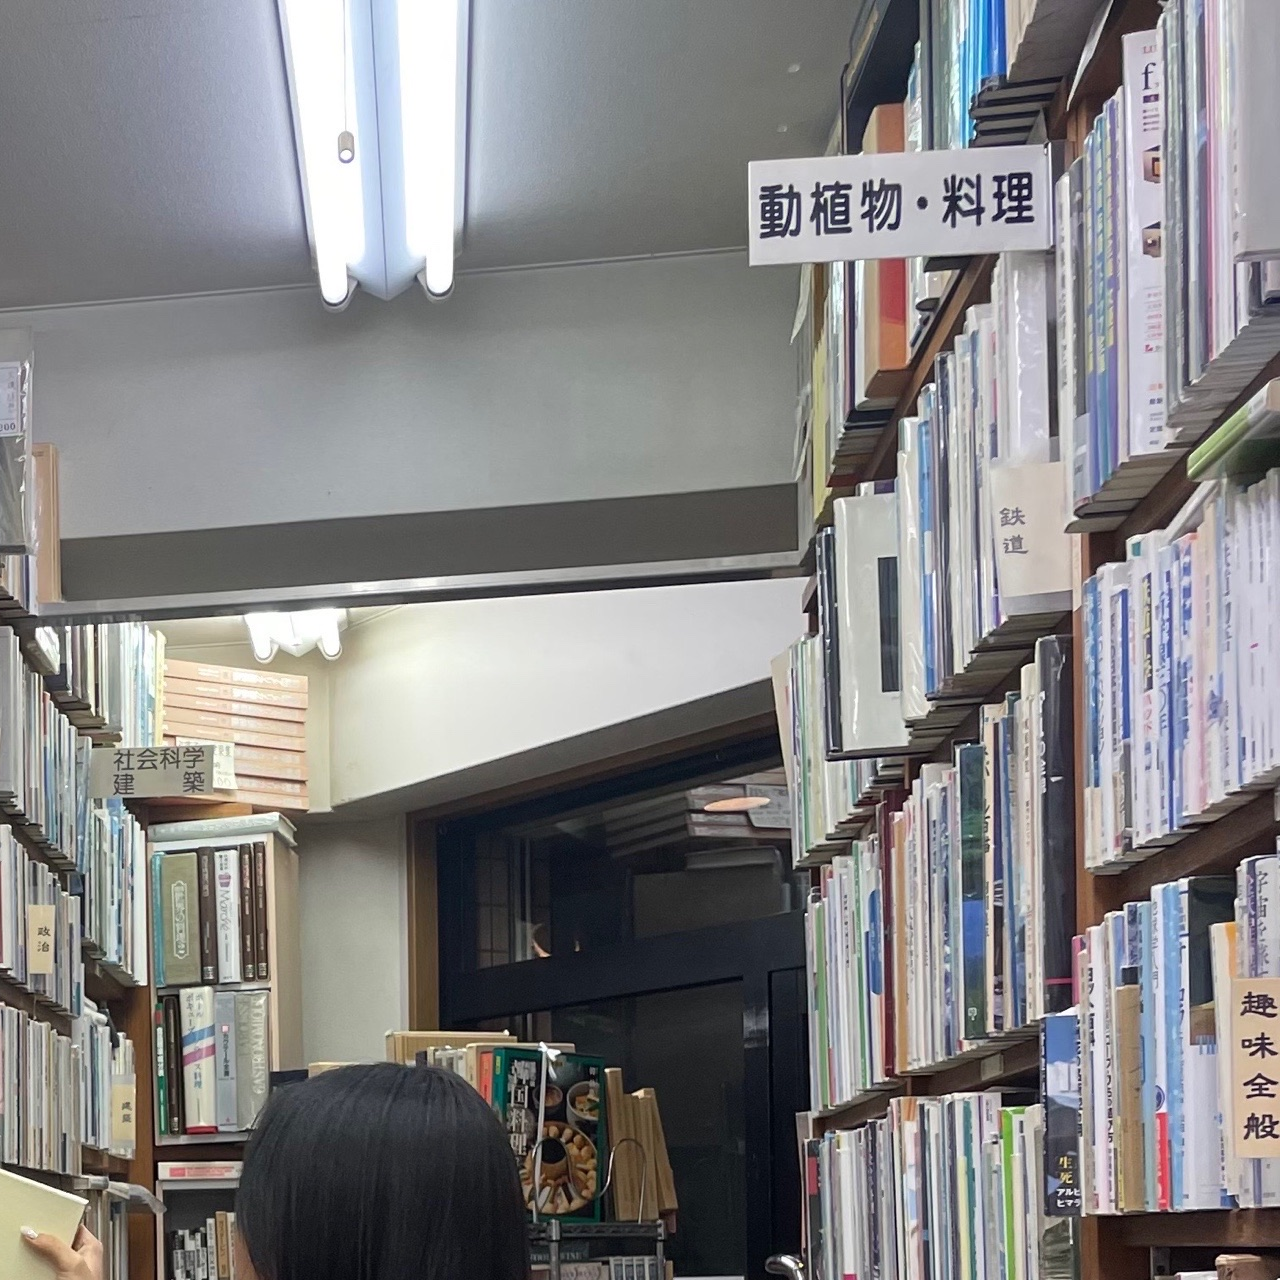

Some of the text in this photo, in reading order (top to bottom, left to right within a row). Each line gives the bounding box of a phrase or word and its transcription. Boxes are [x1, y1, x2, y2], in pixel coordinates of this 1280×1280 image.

[758, 171, 1036, 240] 動植物・料理
[999, 507, 1029, 556] 鉄道
[112, 747, 206, 773] 社会科学
[112, 770, 206, 796] 建築
[37, 925, 52, 953] 政治
[1240, 991, 1279, 1140] 趣味全般
[1058, 1155, 1074, 1184] 生死
